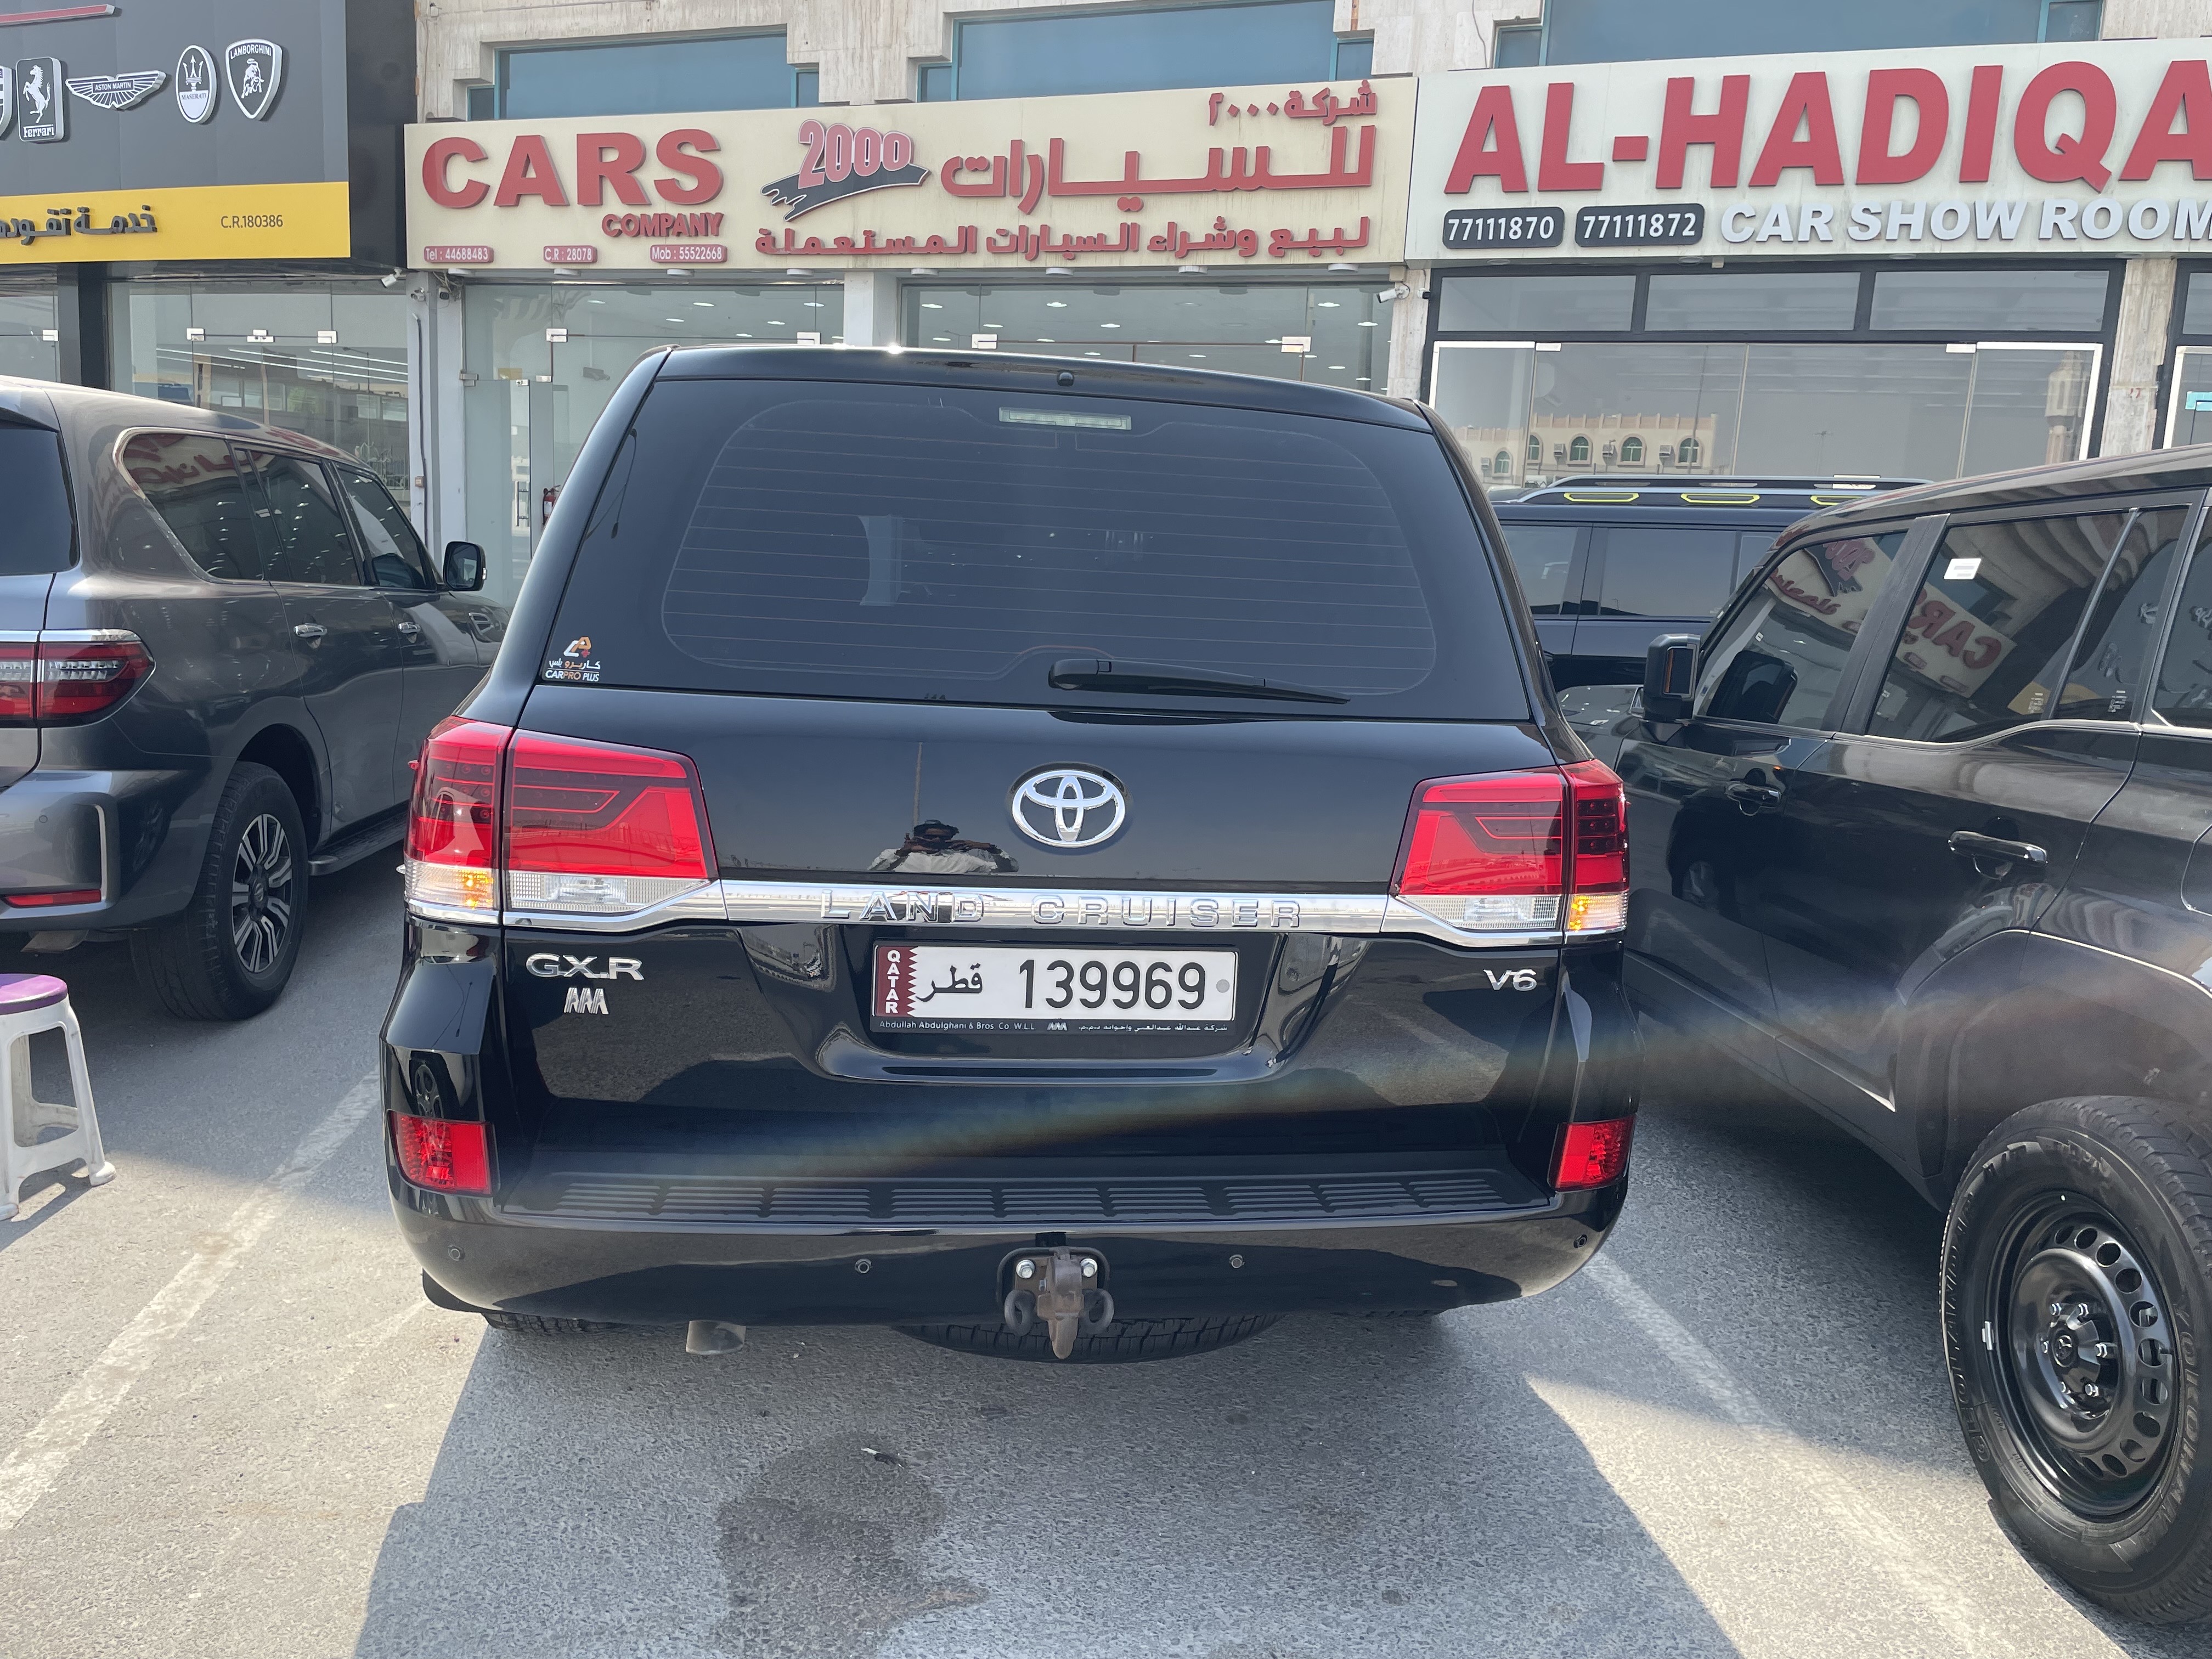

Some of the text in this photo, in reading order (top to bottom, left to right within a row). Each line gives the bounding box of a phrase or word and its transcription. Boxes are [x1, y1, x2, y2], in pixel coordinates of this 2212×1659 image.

[230, 44, 272, 59] LAMBORGHINI
[112, 81, 132, 89] MARTIN
[1284, 80, 1377, 126] شركة
[23, 124, 54, 138] Ferrari
[798, 119, 915, 189] 2000
[422, 128, 724, 209] CARS
[940, 125, 1377, 216] للسيارات
[74, 204, 157, 235] خدمة
[221, 215, 283, 228] C.R.180386
[602, 212, 725, 238] COMPANY
[1447, 216, 1555, 241] 77111870
[1583, 212, 1696, 239] 77111872
[1720, 198, 2212, 243] CAR SHOW ROOM
[755, 216, 1370, 261] لبيع وشراء السيارات المستعملة
[426, 248, 437, 261] Tel
[445, 247, 488, 260] 44688483
[566, 248, 592, 261] 28078
[652, 247, 672, 259] Mob
[679, 246, 722, 259] 55522668
[545, 669, 600, 682] CARPRO PLUS
[820, 889, 1301, 928] LAND CRUISER
[885, 950, 901, 1014] QATAR
[916, 962, 983, 1002] قطر
[1019, 959, 1206, 1010] 139969
[1483, 968, 1537, 992] V6
[879, 1020, 917, 1029] Abdullah
[918, 1021, 967, 1031] Abdulghani
